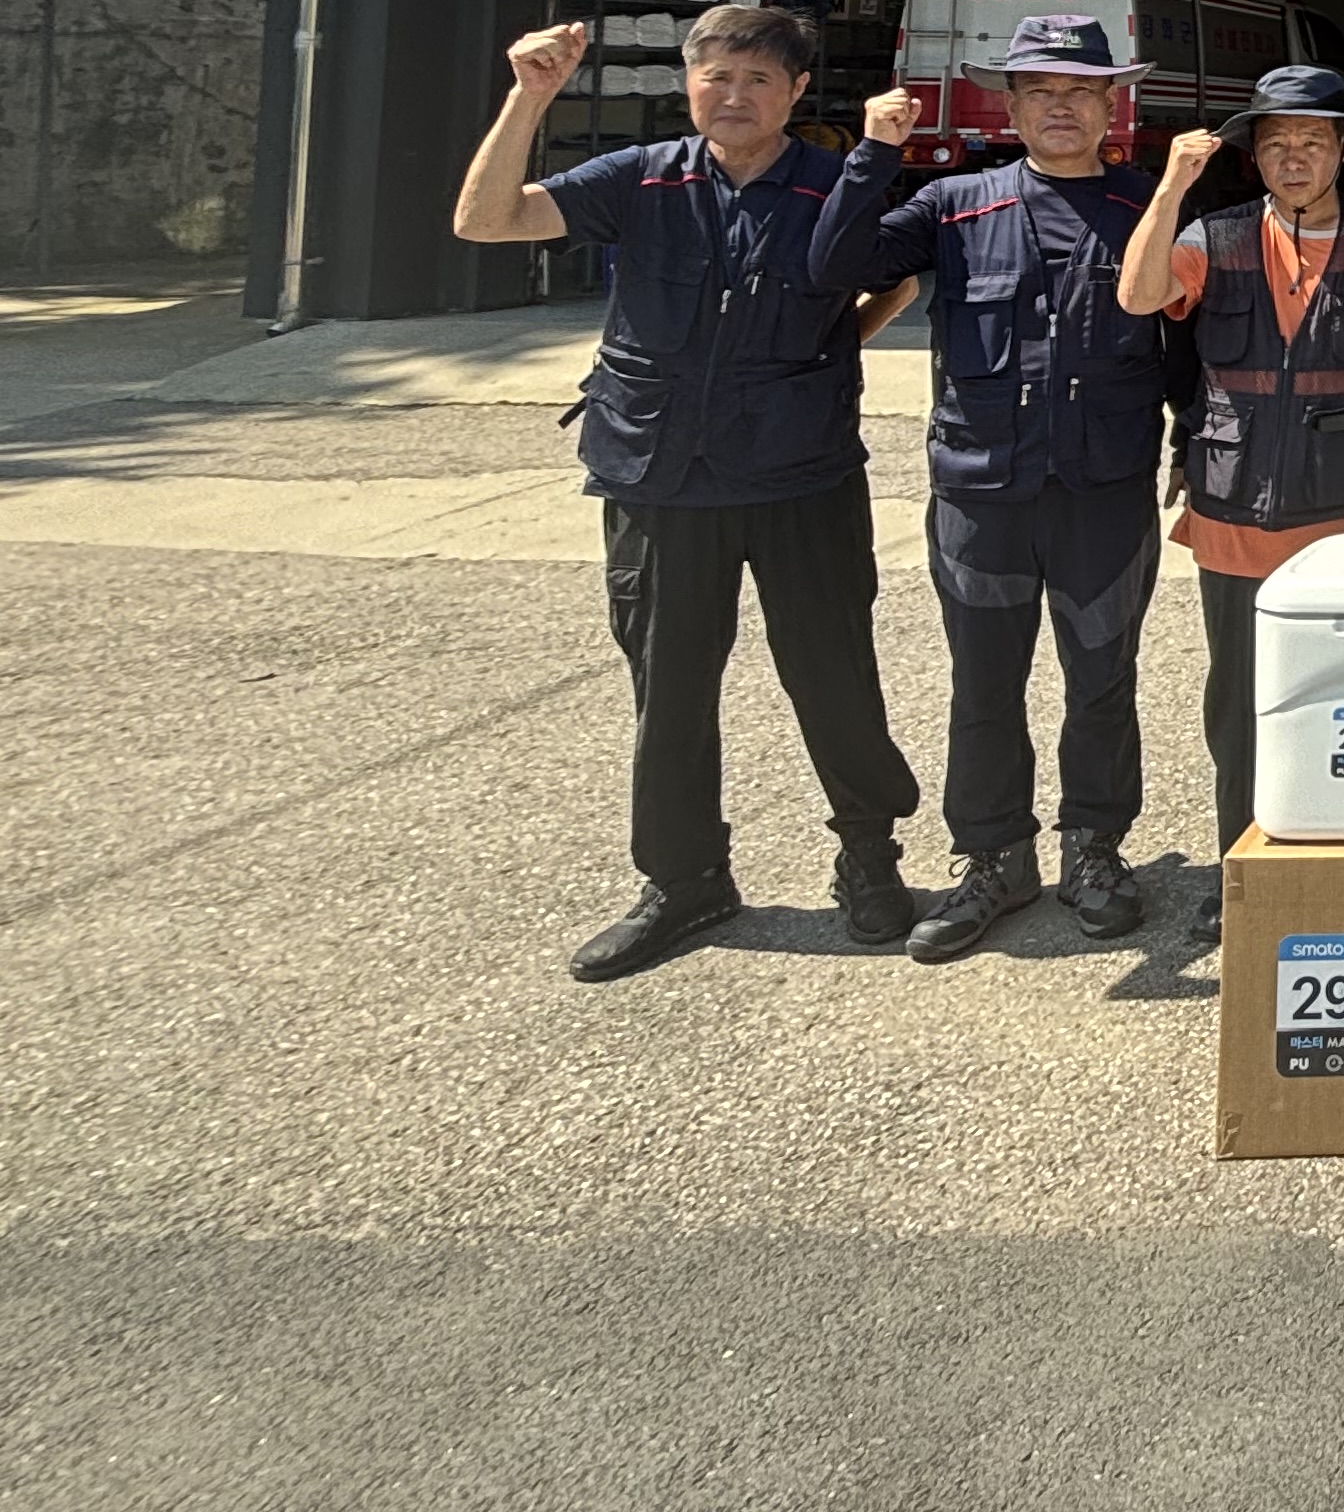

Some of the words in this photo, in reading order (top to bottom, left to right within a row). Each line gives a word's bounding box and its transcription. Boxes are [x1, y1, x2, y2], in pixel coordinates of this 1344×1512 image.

[1292, 943, 1344, 956] smato
[1290, 1036, 1324, 1049] 마스터
[1289, 1057, 1310, 1071] PU
